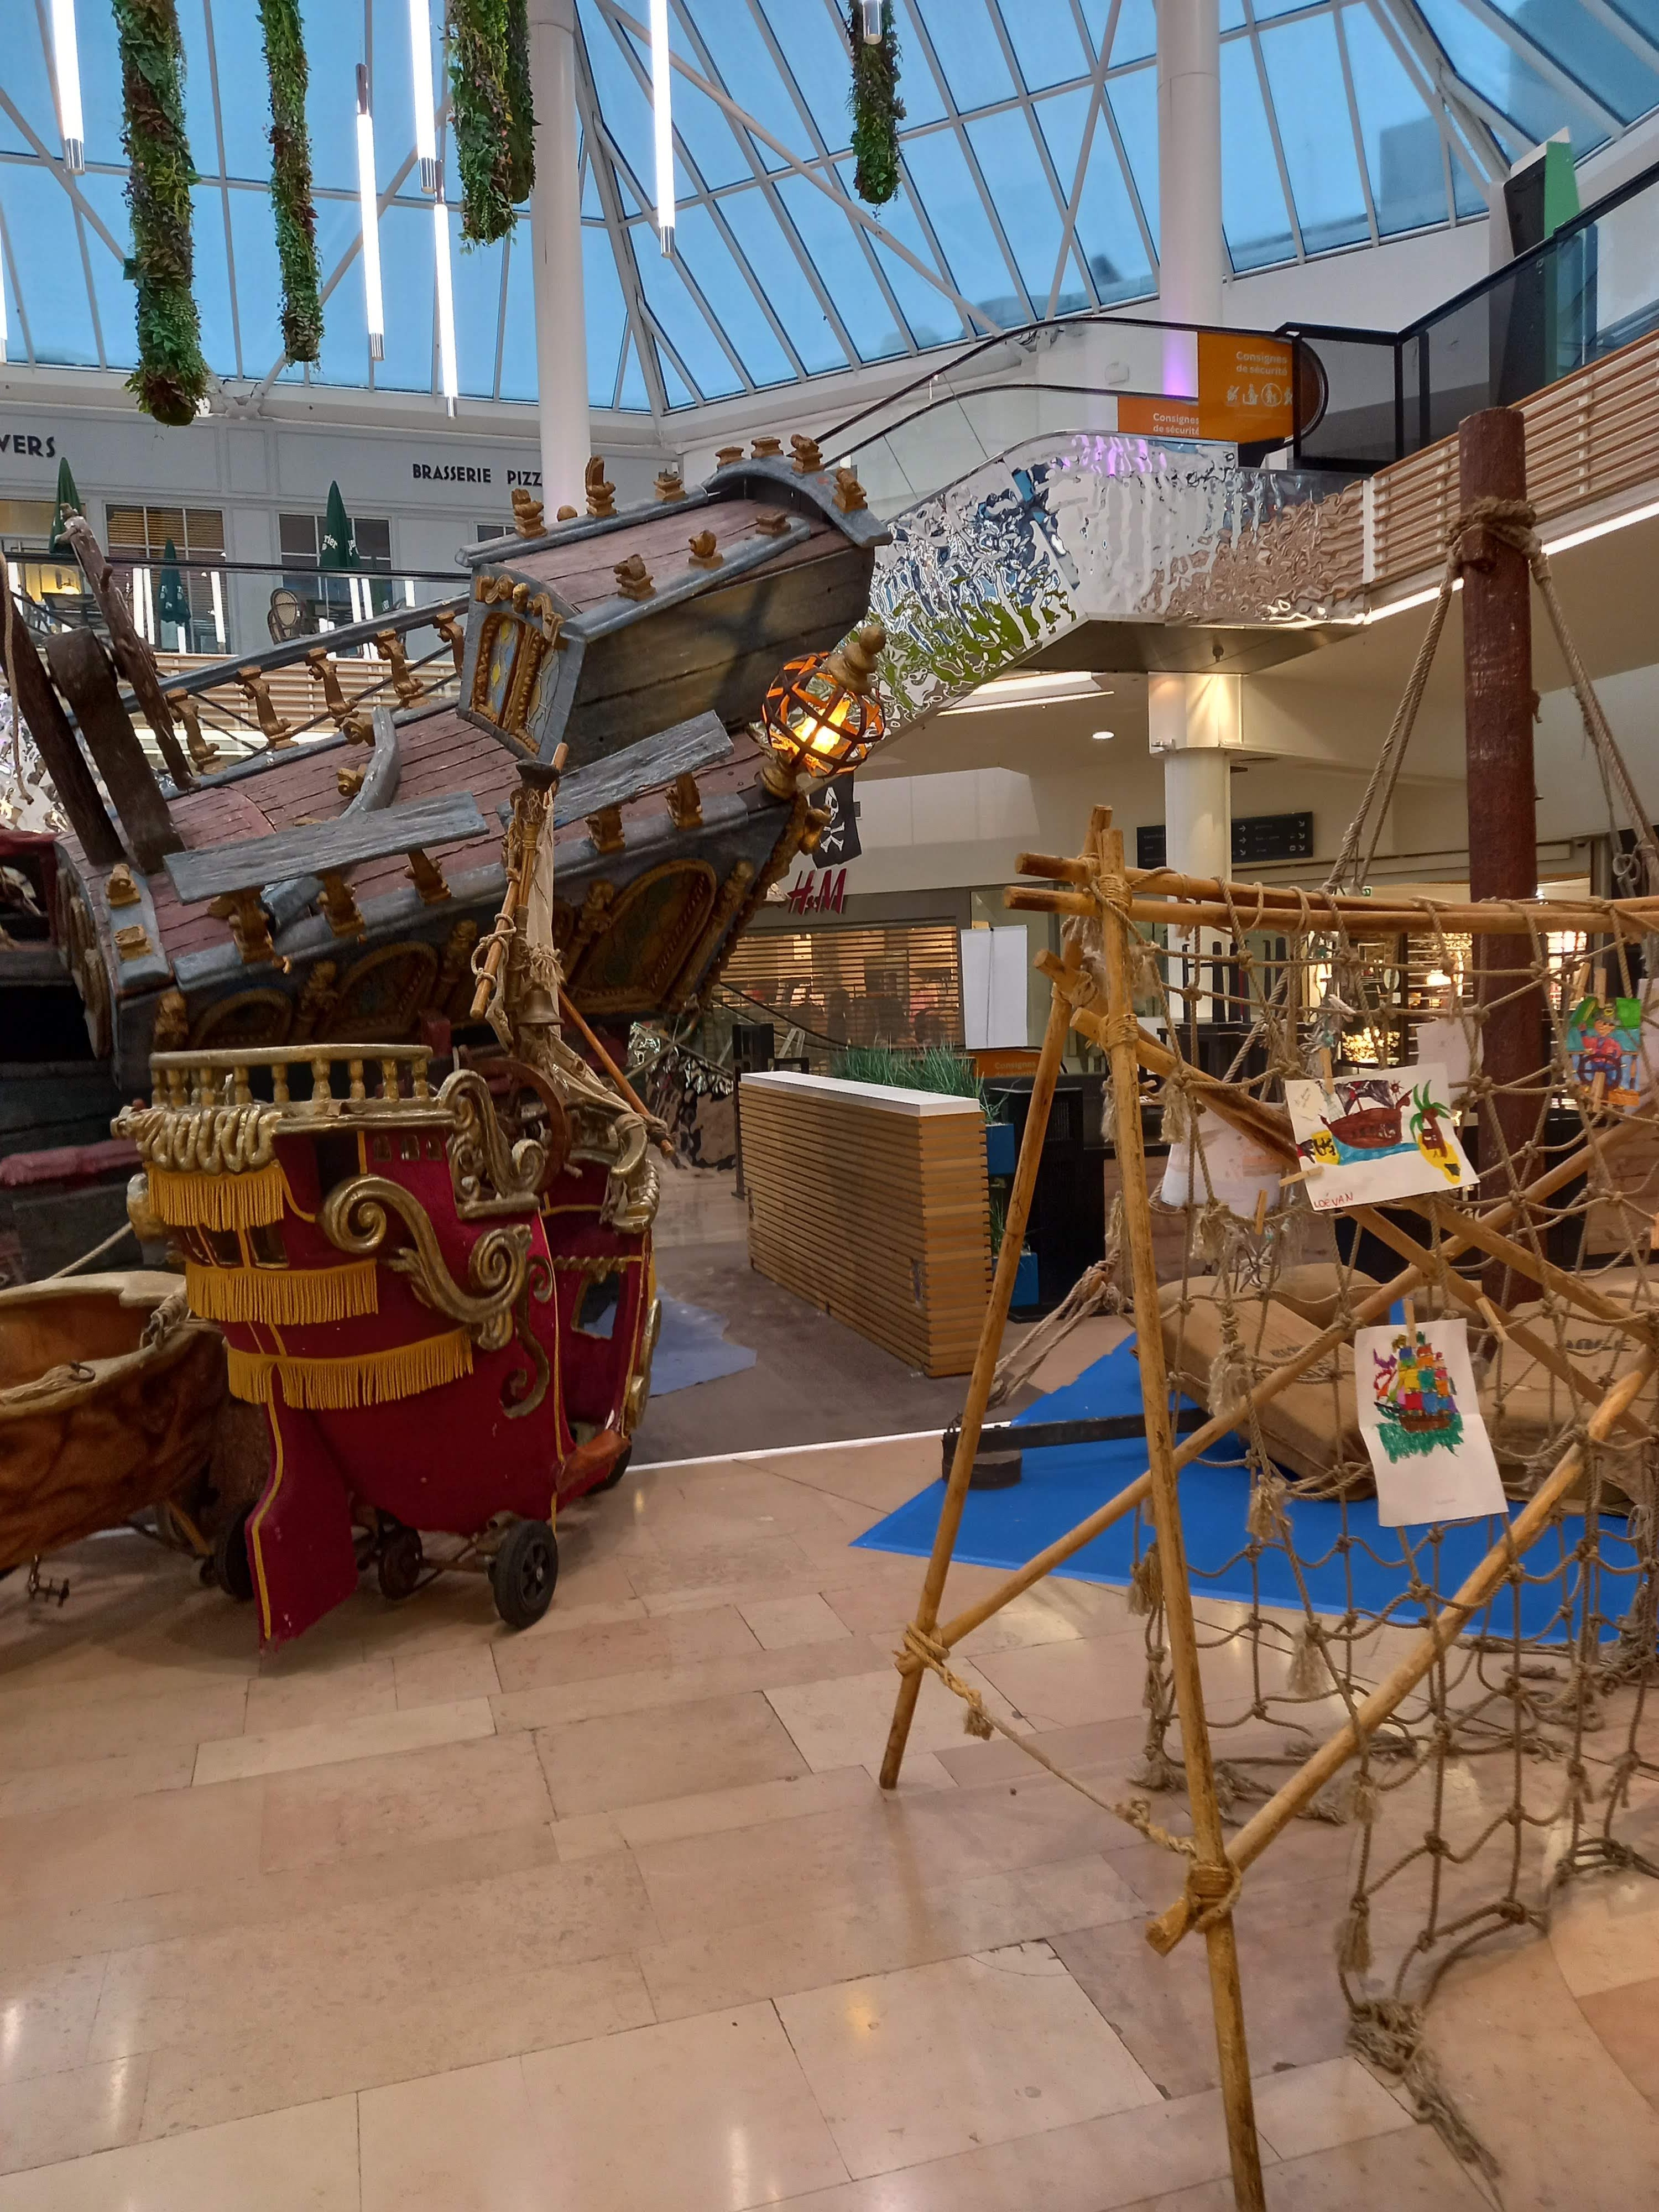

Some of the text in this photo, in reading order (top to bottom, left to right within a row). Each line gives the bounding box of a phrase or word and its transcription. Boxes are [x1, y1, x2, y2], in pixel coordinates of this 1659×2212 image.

[1236, 351, 1287, 364] Consignes
[1237, 364, 1287, 376] de sécurité
[413, 463, 491, 483] BRASSERIE
[787, 868, 847, 915] H&M
